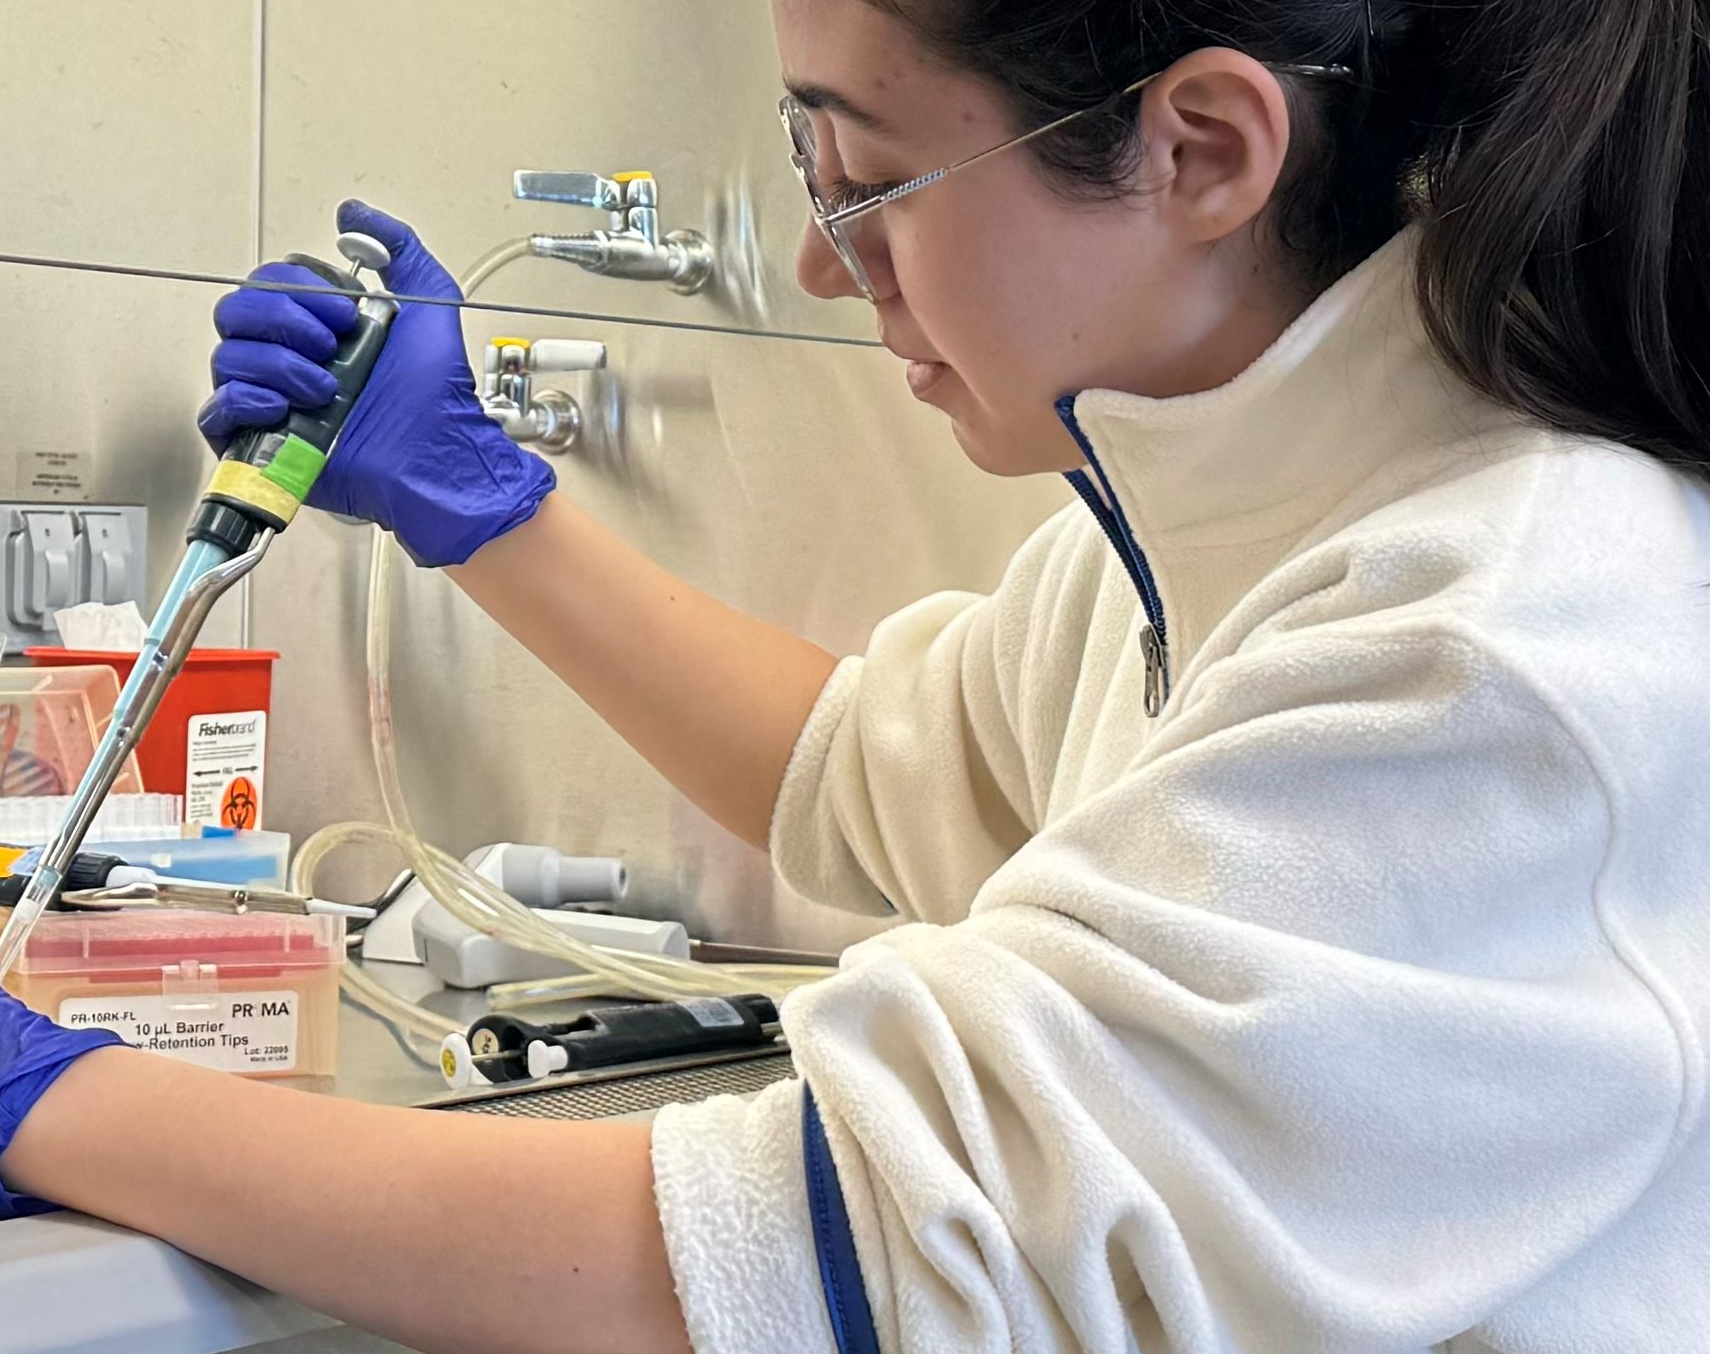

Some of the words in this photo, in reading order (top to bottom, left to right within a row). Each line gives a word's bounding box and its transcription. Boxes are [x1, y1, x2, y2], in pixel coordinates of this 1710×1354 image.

[136, 1023, 150, 1035] 10
[176, 1021, 225, 1036] Barrier
[220, 1034, 249, 1050] Tips
